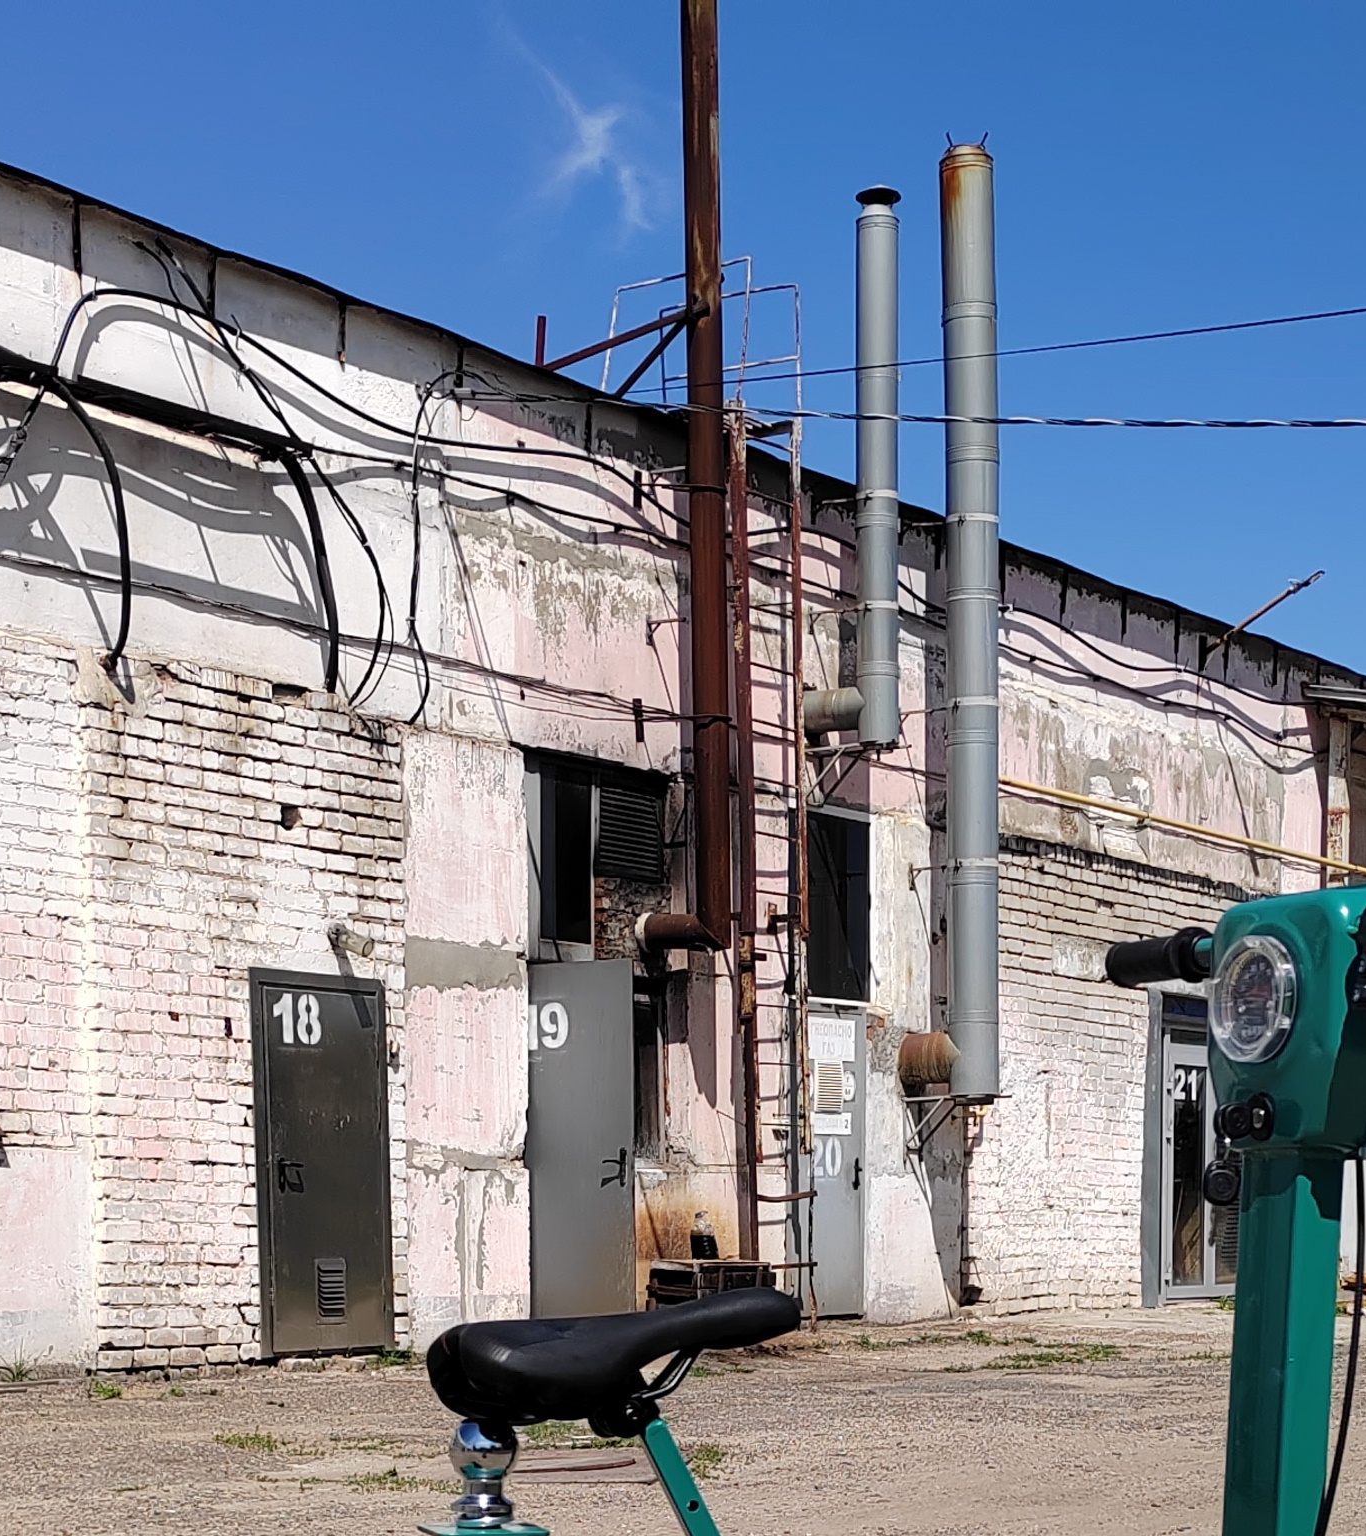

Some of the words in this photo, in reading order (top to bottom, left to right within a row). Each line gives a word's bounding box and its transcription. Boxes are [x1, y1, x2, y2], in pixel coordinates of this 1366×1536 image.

[272, 992, 322, 1045] 18
[810, 1022, 853, 1039] ГНЕОПАСНО
[1174, 1068, 1197, 1101] 21
[807, 1136, 842, 1177] 20
